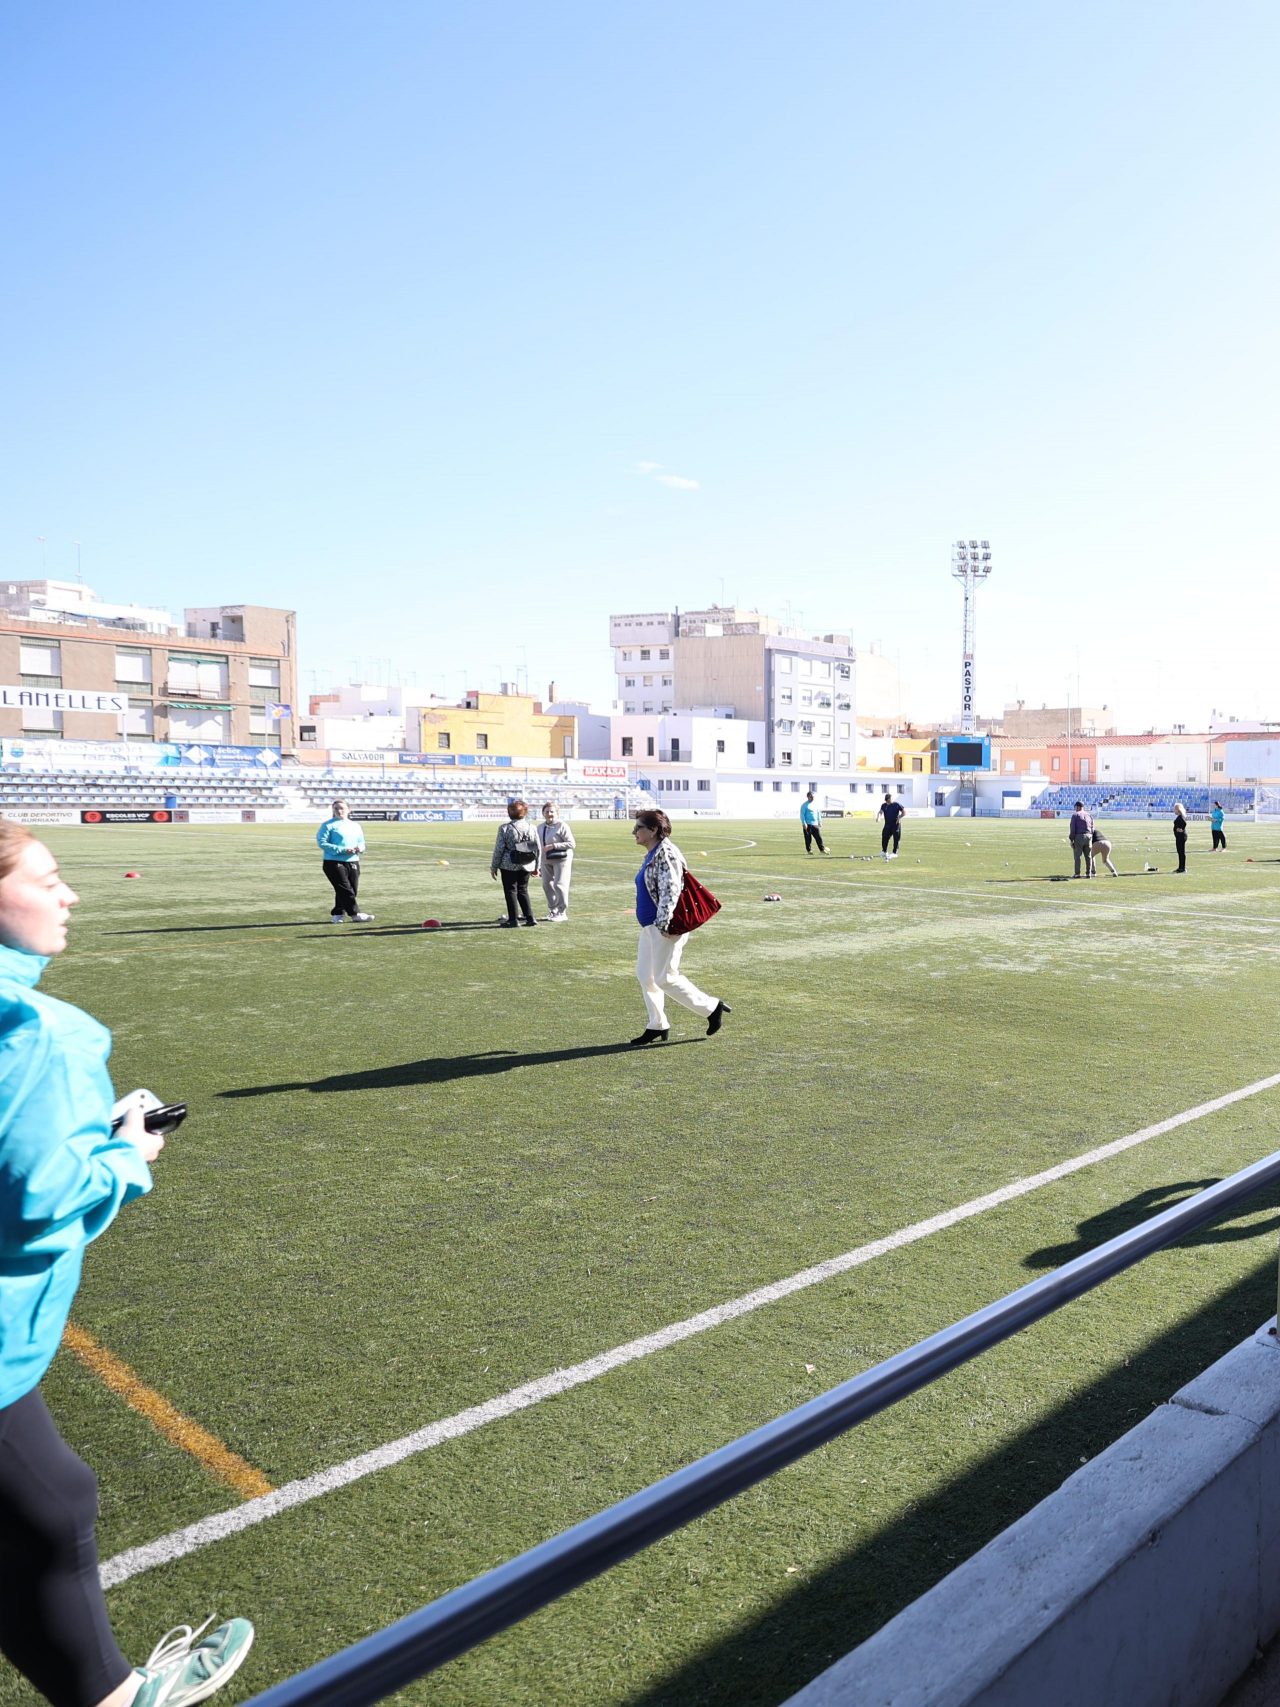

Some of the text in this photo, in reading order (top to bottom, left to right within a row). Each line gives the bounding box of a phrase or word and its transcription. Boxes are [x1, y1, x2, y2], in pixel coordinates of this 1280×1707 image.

[963, 661, 971, 711] PASTOR
[341, 752, 385, 761] SALVADOR
[585, 767, 624, 775] MAKASA
